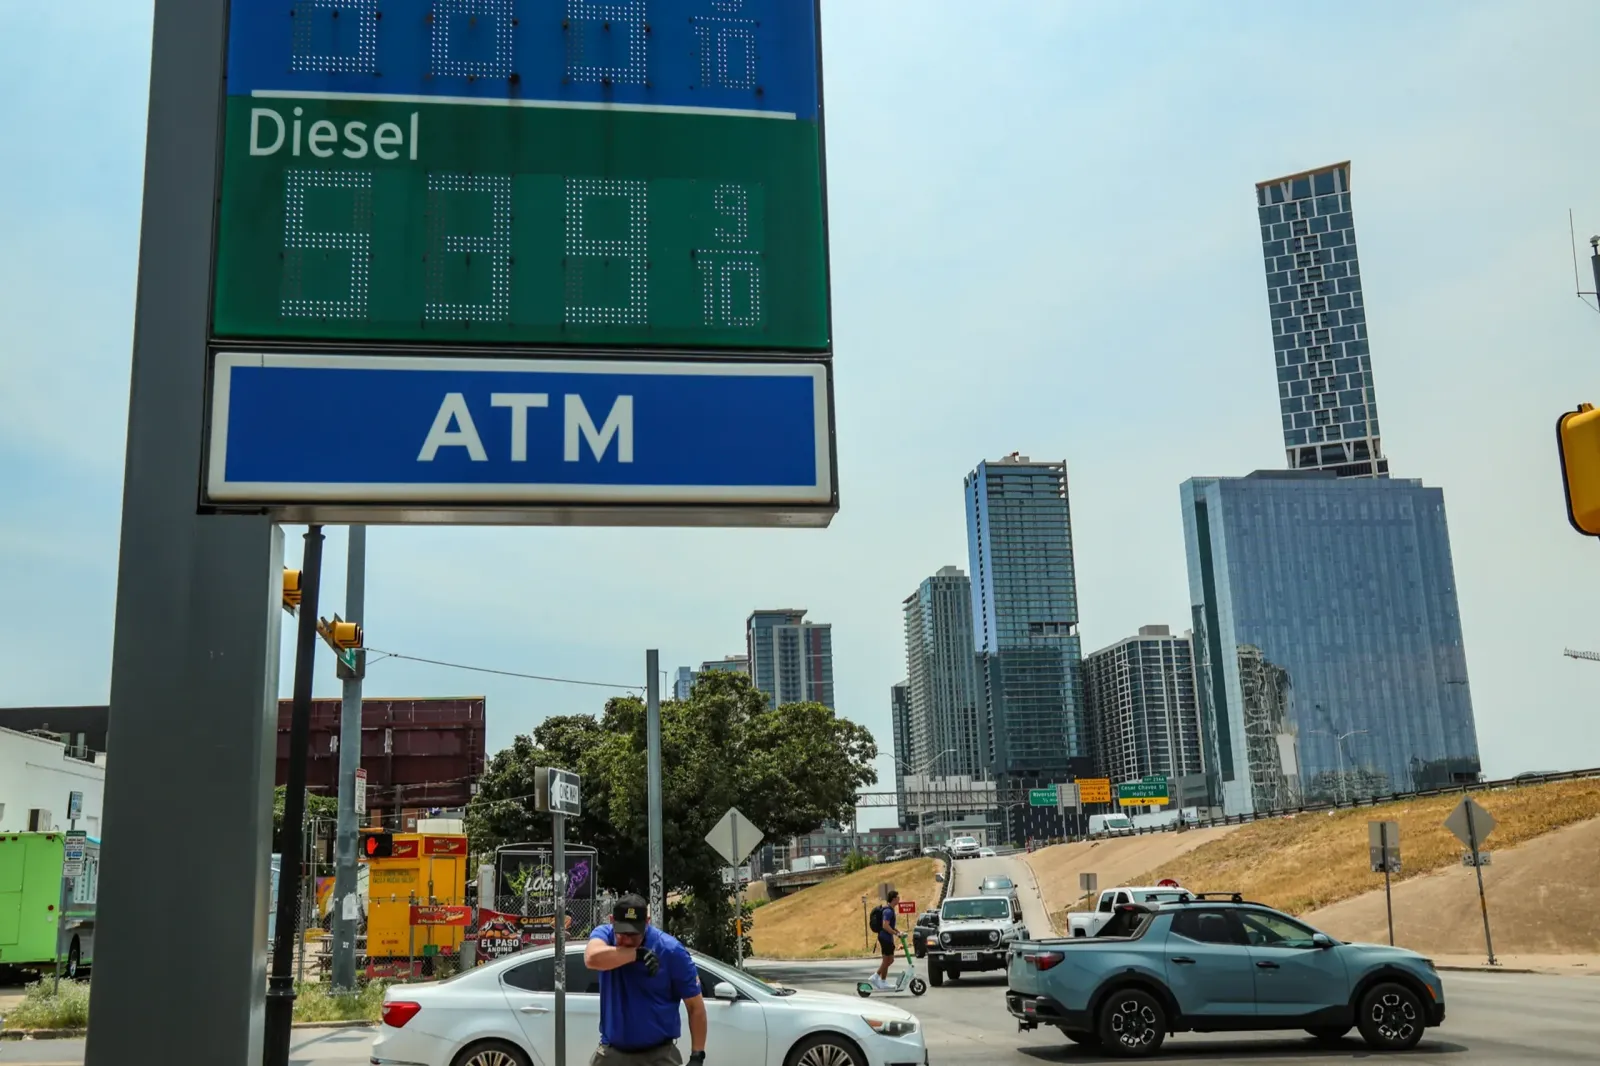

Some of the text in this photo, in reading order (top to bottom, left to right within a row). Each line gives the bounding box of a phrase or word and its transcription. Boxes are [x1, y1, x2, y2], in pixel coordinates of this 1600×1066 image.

[250, 106, 418, 161] Diesel
[697, 260, 760, 327] 10
[417, 391, 634, 464] ATM
[481, 939, 519, 947] EL PASO
